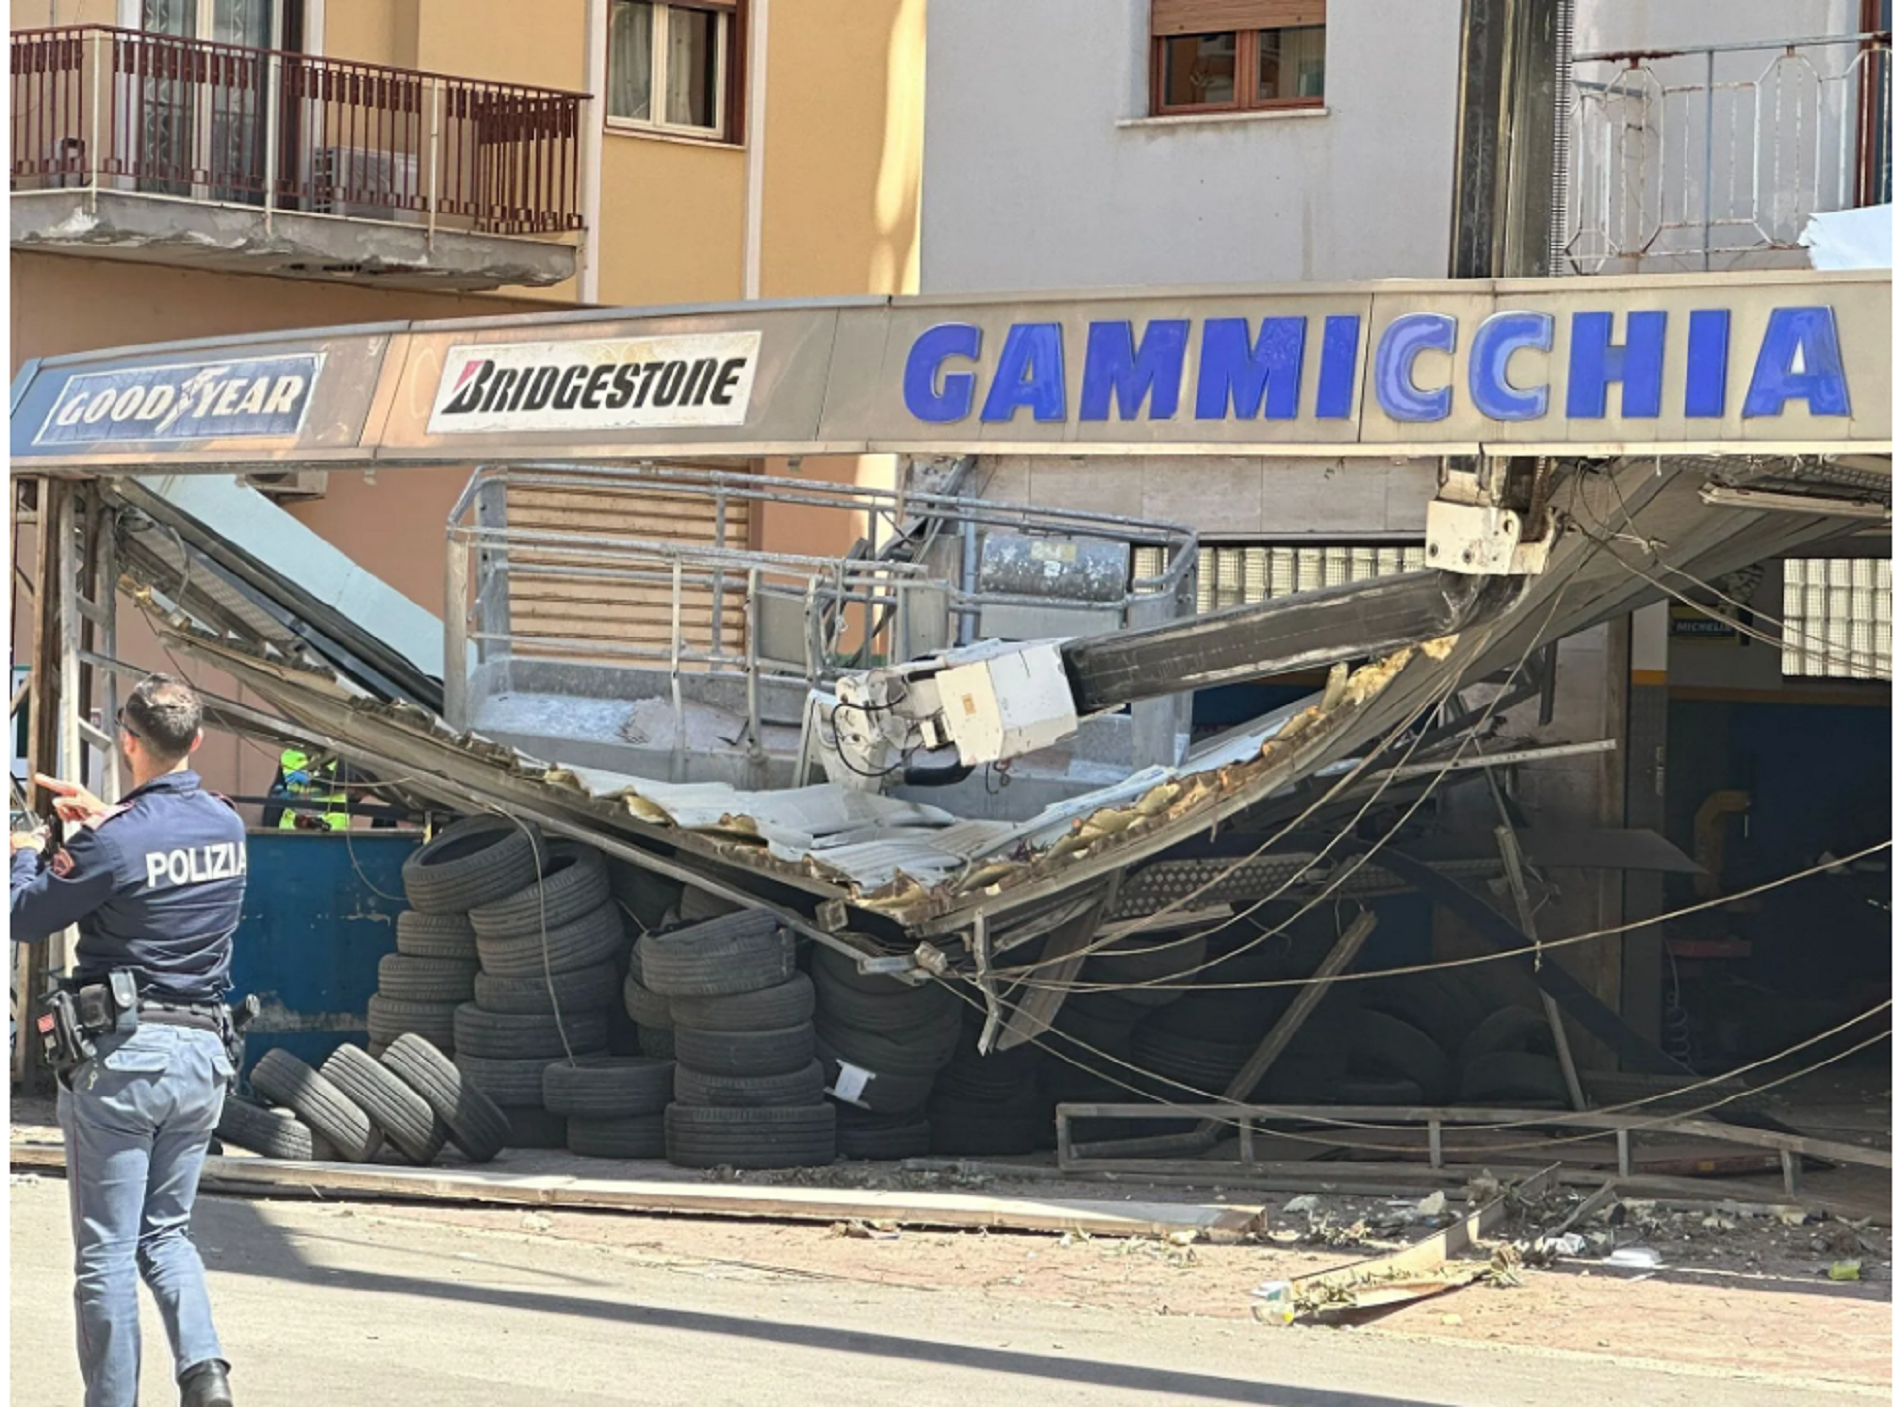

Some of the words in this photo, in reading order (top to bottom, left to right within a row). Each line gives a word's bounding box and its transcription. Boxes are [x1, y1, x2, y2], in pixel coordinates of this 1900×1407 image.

[441, 357, 748, 414] BRIDGESTONE
[901, 304, 1852, 424] GAMMICCHIA
[145, 841, 246, 888] POLIZIA
